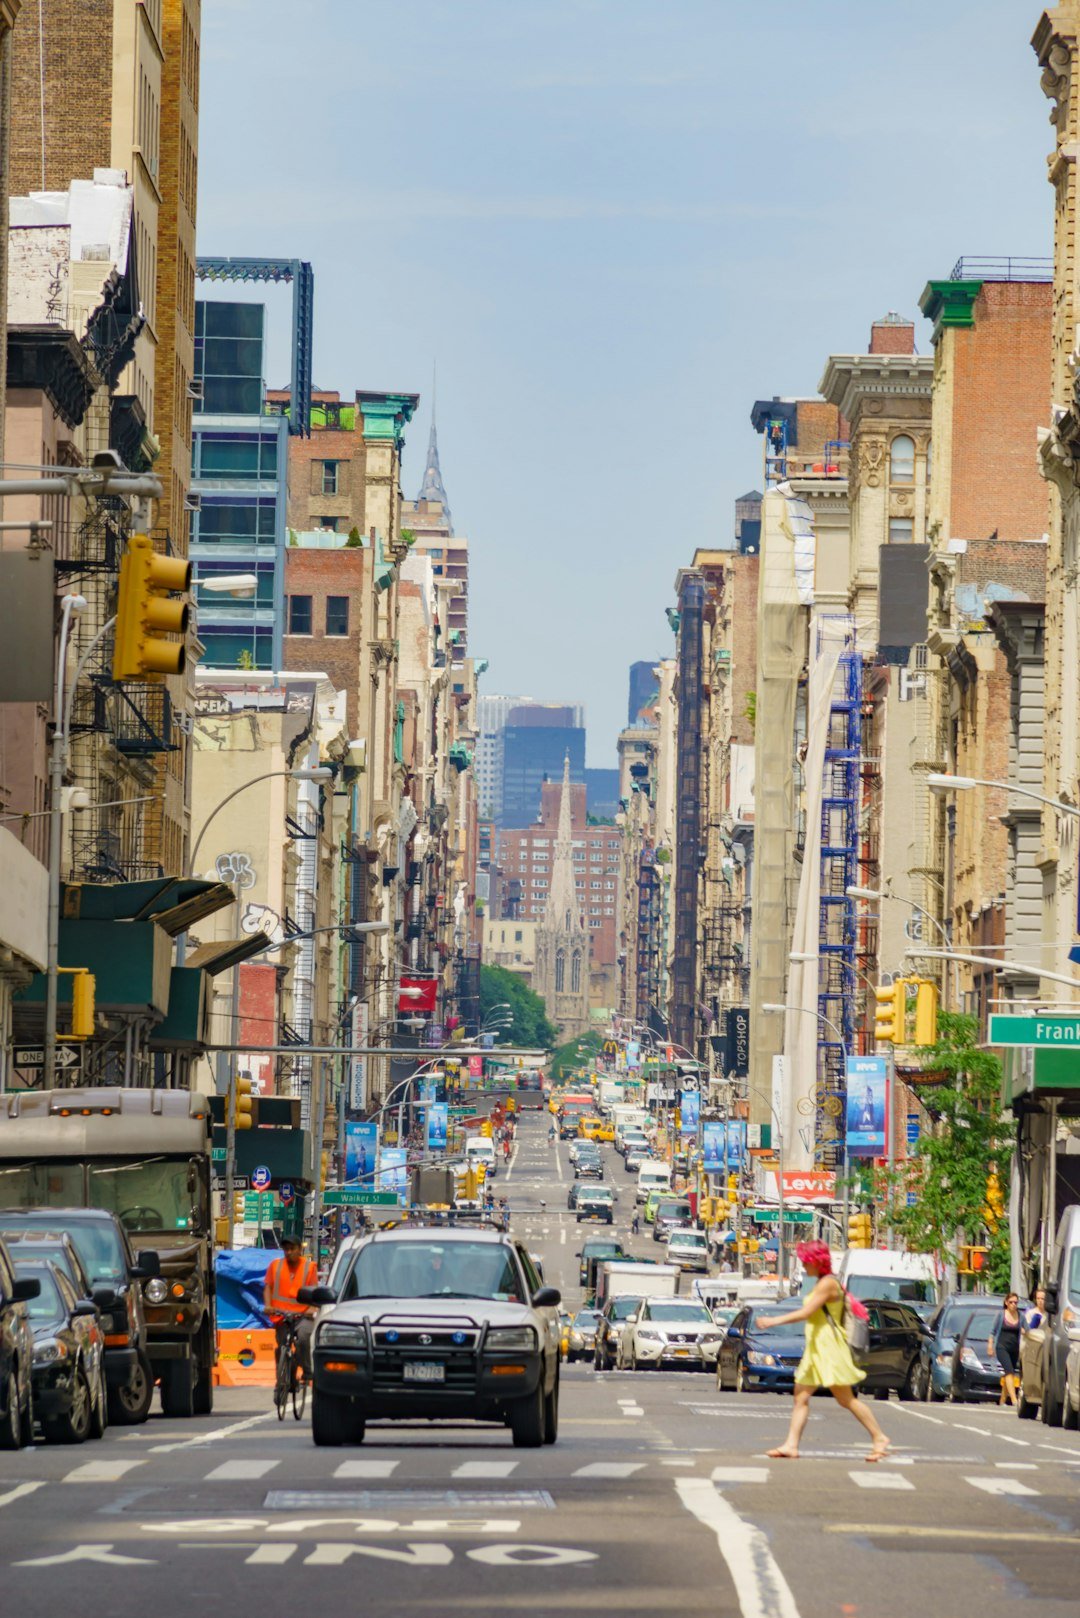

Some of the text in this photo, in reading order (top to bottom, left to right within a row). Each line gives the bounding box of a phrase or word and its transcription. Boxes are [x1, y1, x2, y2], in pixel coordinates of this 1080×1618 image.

[736, 1014, 747, 1067] TOPSHOP
[22, 1053, 41, 1061] ONE
[341, 1194, 380, 1202] Walker St
[771, 1212, 790, 1220] Caal
[10, 1543, 599, 1566] ONLY
